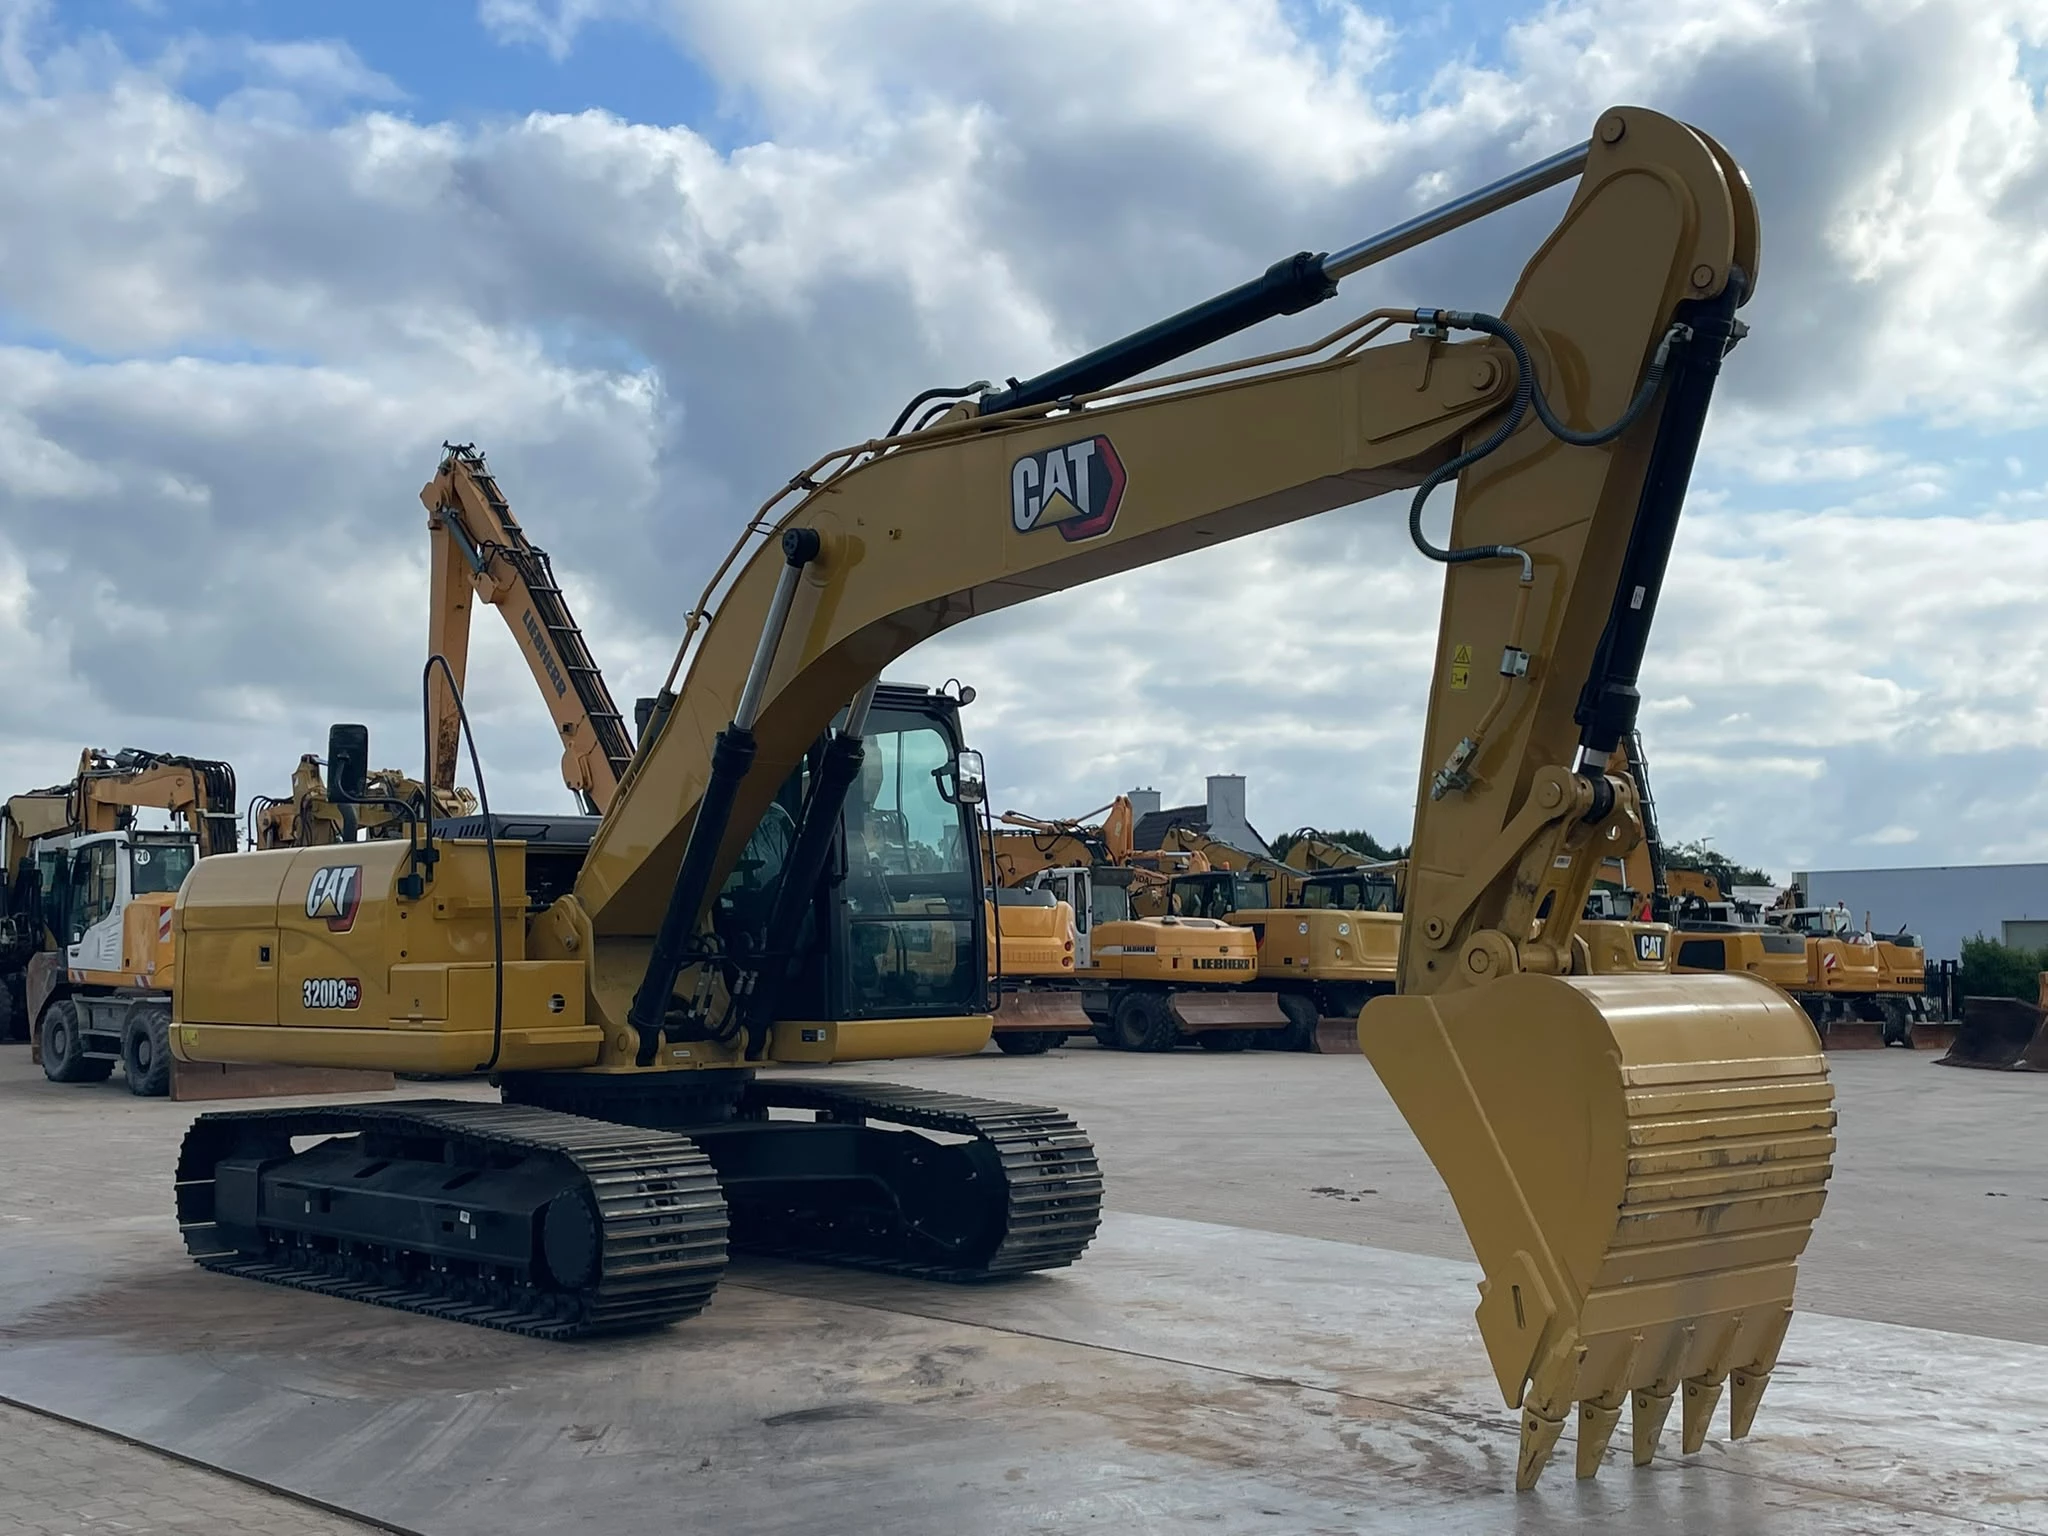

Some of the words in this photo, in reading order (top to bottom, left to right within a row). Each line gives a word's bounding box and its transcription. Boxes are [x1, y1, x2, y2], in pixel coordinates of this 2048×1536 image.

[1013, 440, 1095, 531] CAT
[137, 851, 149, 862] 20
[307, 866, 357, 917] CAT
[1641, 935, 1662, 959] CAT
[1193, 958, 1250, 970] LIEBHERR
